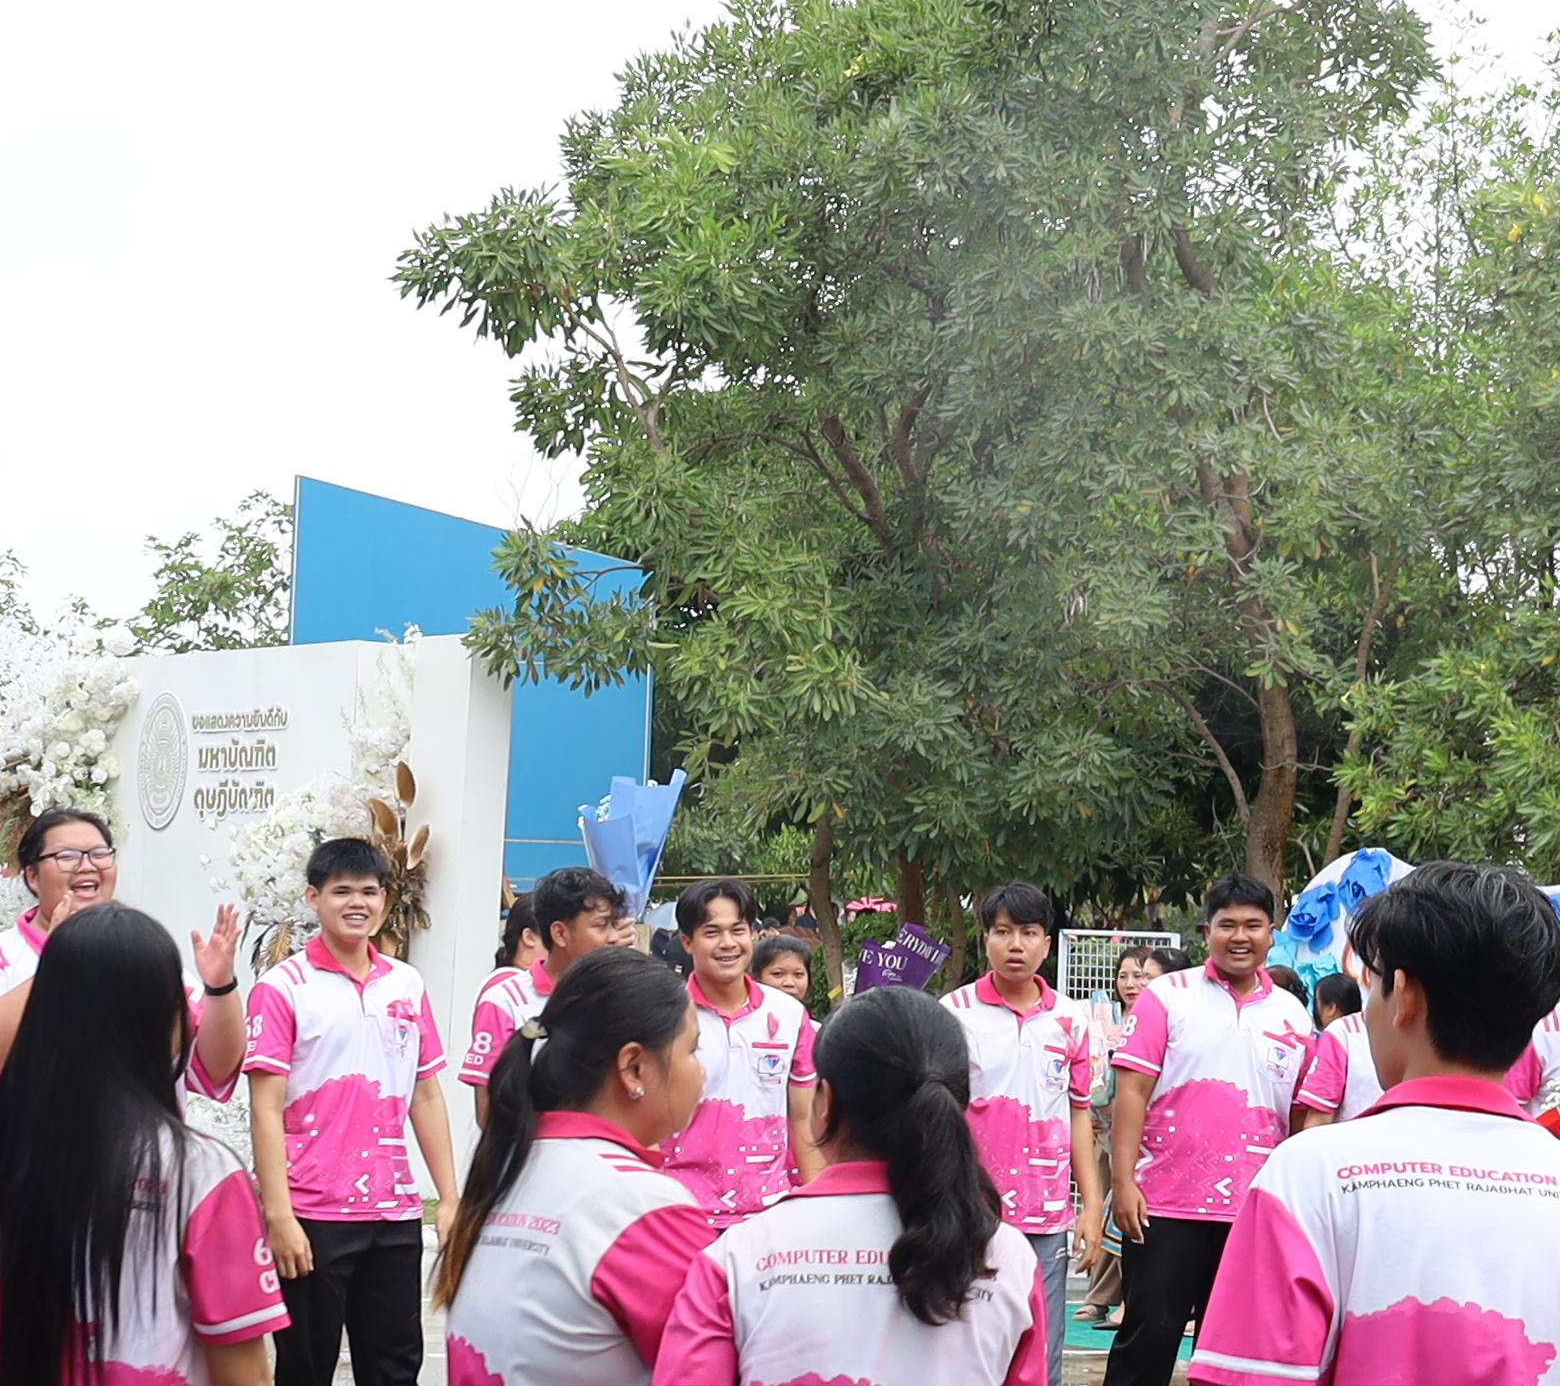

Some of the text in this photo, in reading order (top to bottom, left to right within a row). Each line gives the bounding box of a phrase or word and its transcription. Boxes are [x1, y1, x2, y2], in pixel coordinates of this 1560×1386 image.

[198, 738, 277, 770] มหาบัณฑิต
[877, 952, 909, 971] YOU
[1337, 1161, 1443, 1180] COMPUTER
[1449, 1165, 1557, 1187] EDUCATION
[1341, 1177, 1425, 1195] KAMPHAENG
[1428, 1178, 1461, 1190] PHET
[1466, 1182, 1533, 1196] RAJABHAT
[756, 1250, 848, 1271] COMPUTER
[759, 1274, 830, 1292] KAMPHAENG
[833, 1274, 863, 1285] PHET
